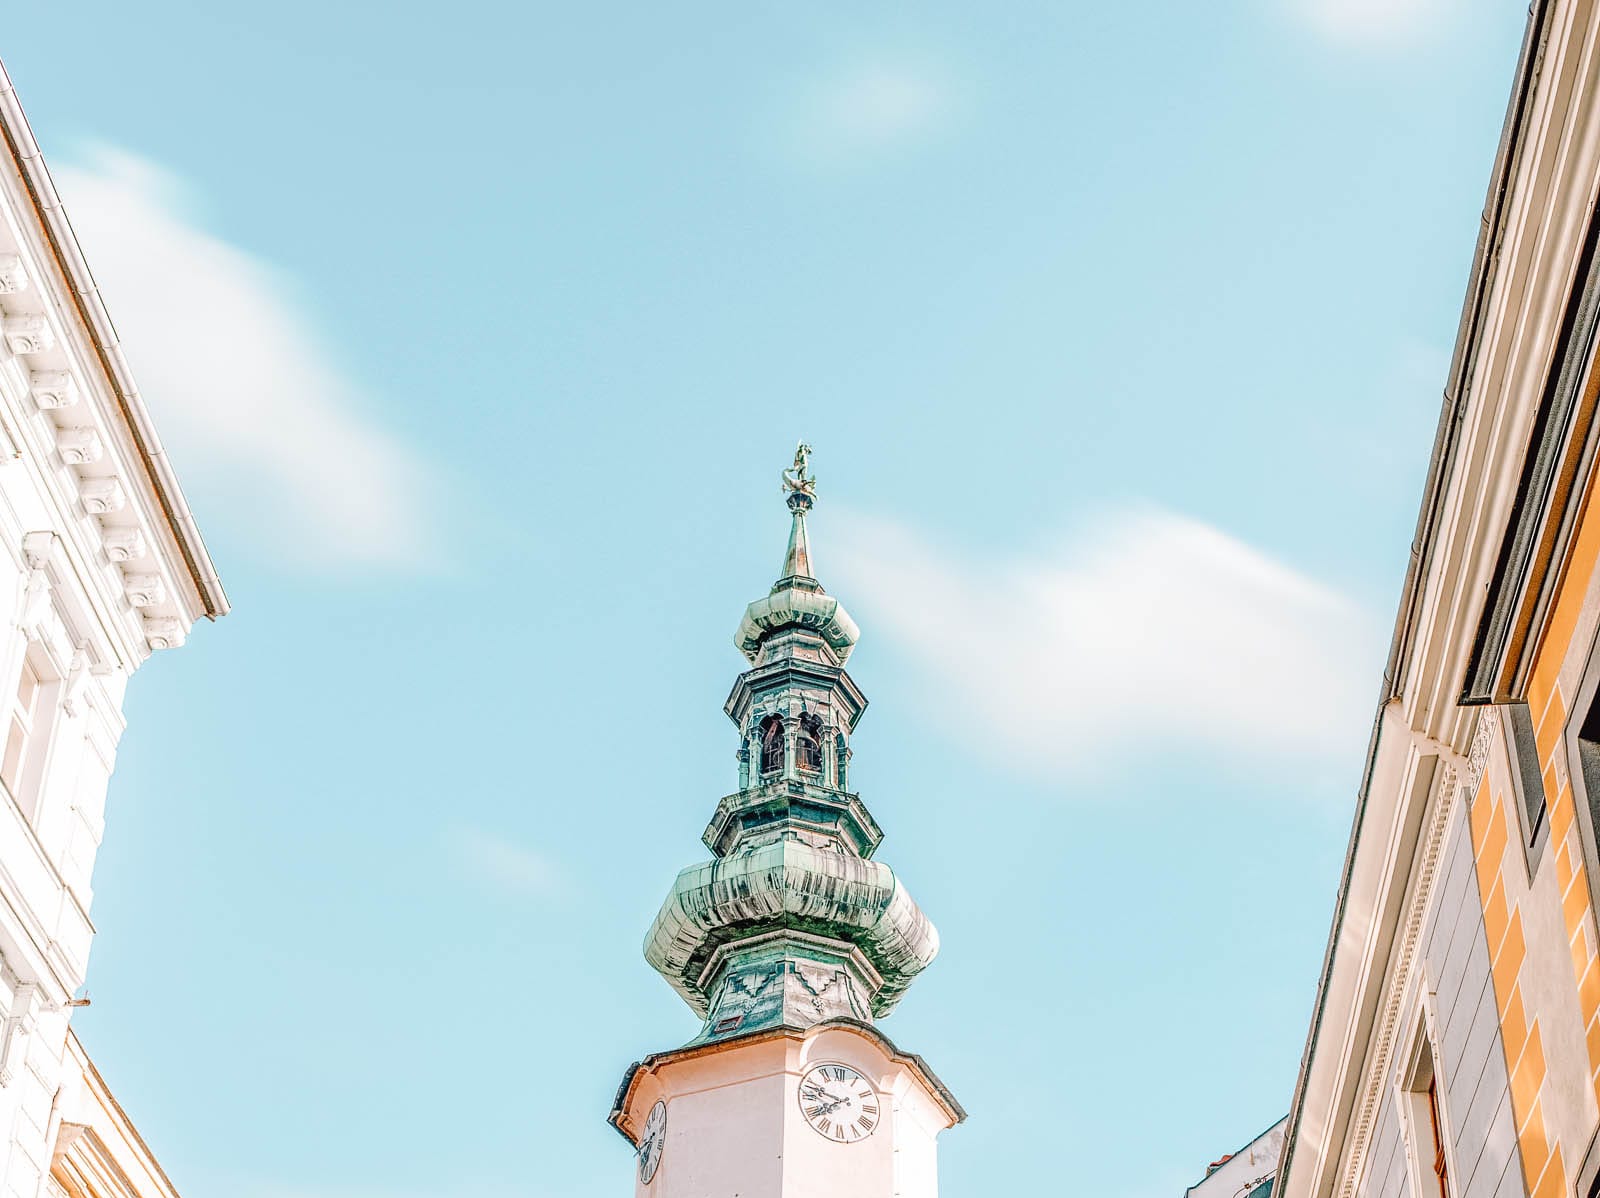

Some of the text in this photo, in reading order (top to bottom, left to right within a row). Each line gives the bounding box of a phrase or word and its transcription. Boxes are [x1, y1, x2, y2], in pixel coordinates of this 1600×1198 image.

[818, 1068, 831, 1083] XI
[833, 1067, 845, 1082] XII
[850, 1076, 859, 1087] I
[859, 1090, 872, 1098] II
[862, 1105, 877, 1114] III
[817, 1117, 831, 1133] VII
[858, 1115, 874, 1130] IIII
[836, 1124, 846, 1139] VI
[851, 1124, 861, 1138] V
